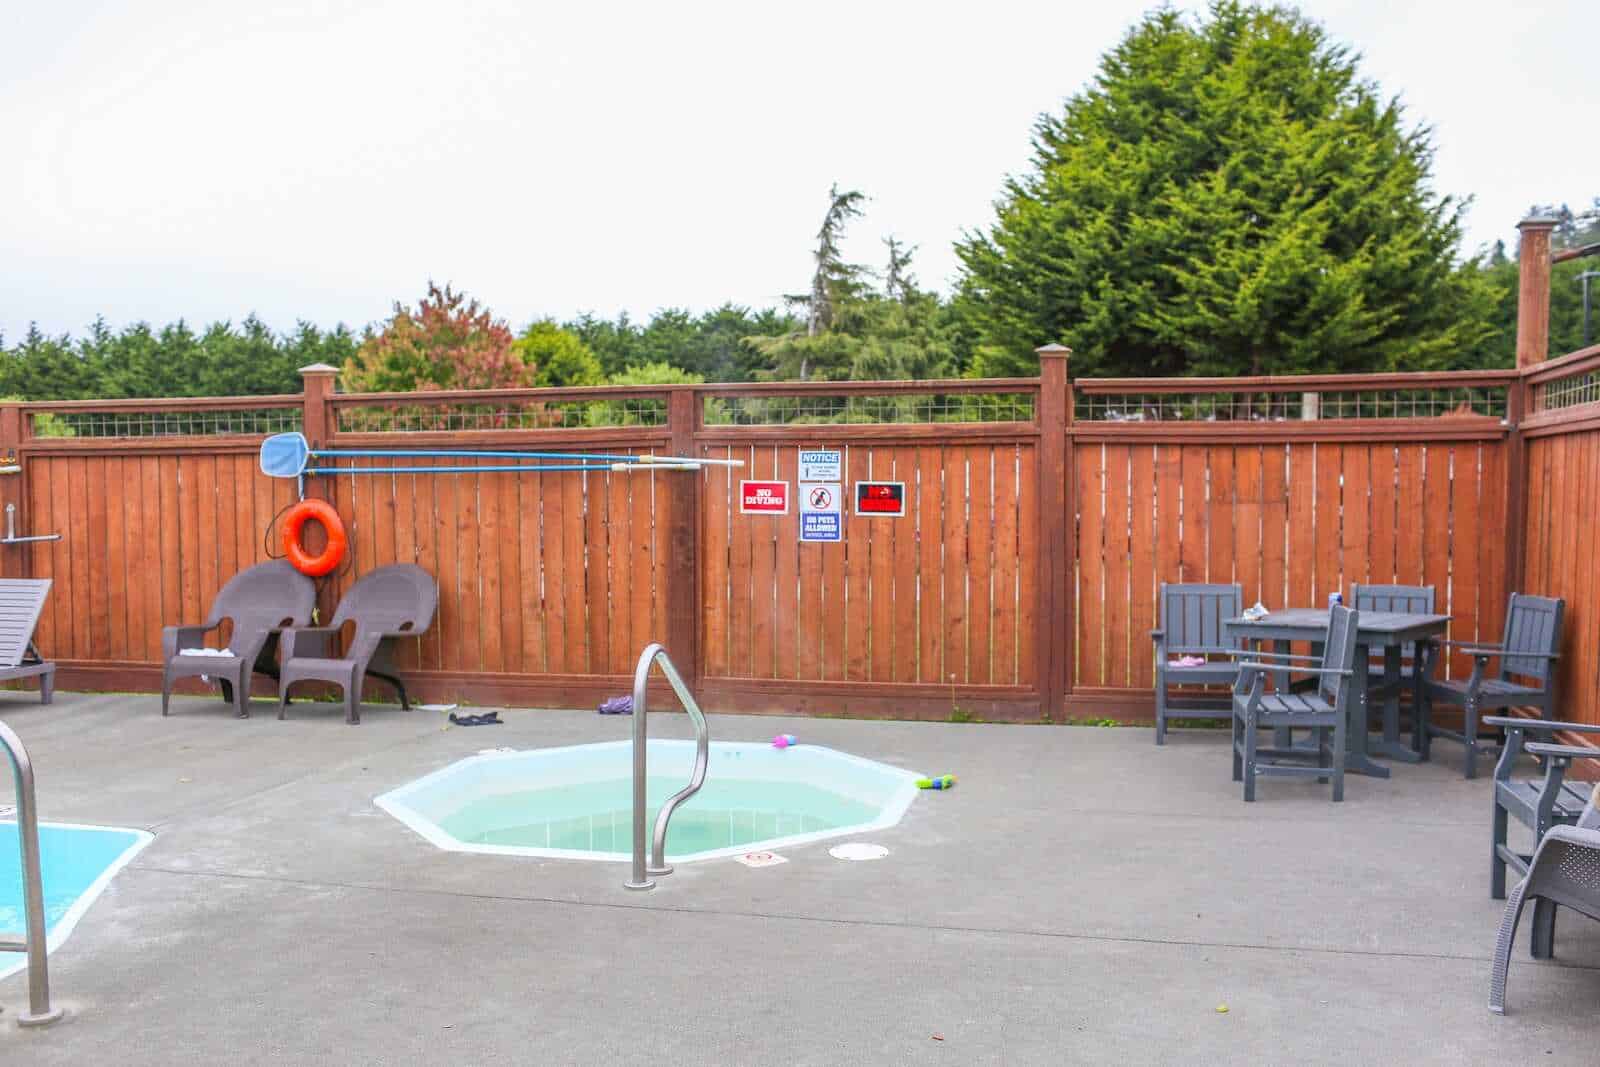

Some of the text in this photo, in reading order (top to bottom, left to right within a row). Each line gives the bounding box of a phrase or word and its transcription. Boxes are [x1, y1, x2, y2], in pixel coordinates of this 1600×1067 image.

[803, 453, 838, 463] NOTICE
[756, 488, 772, 497] NO
[745, 496, 783, 505] DIVING
[805, 524, 837, 532] ALLOWED
